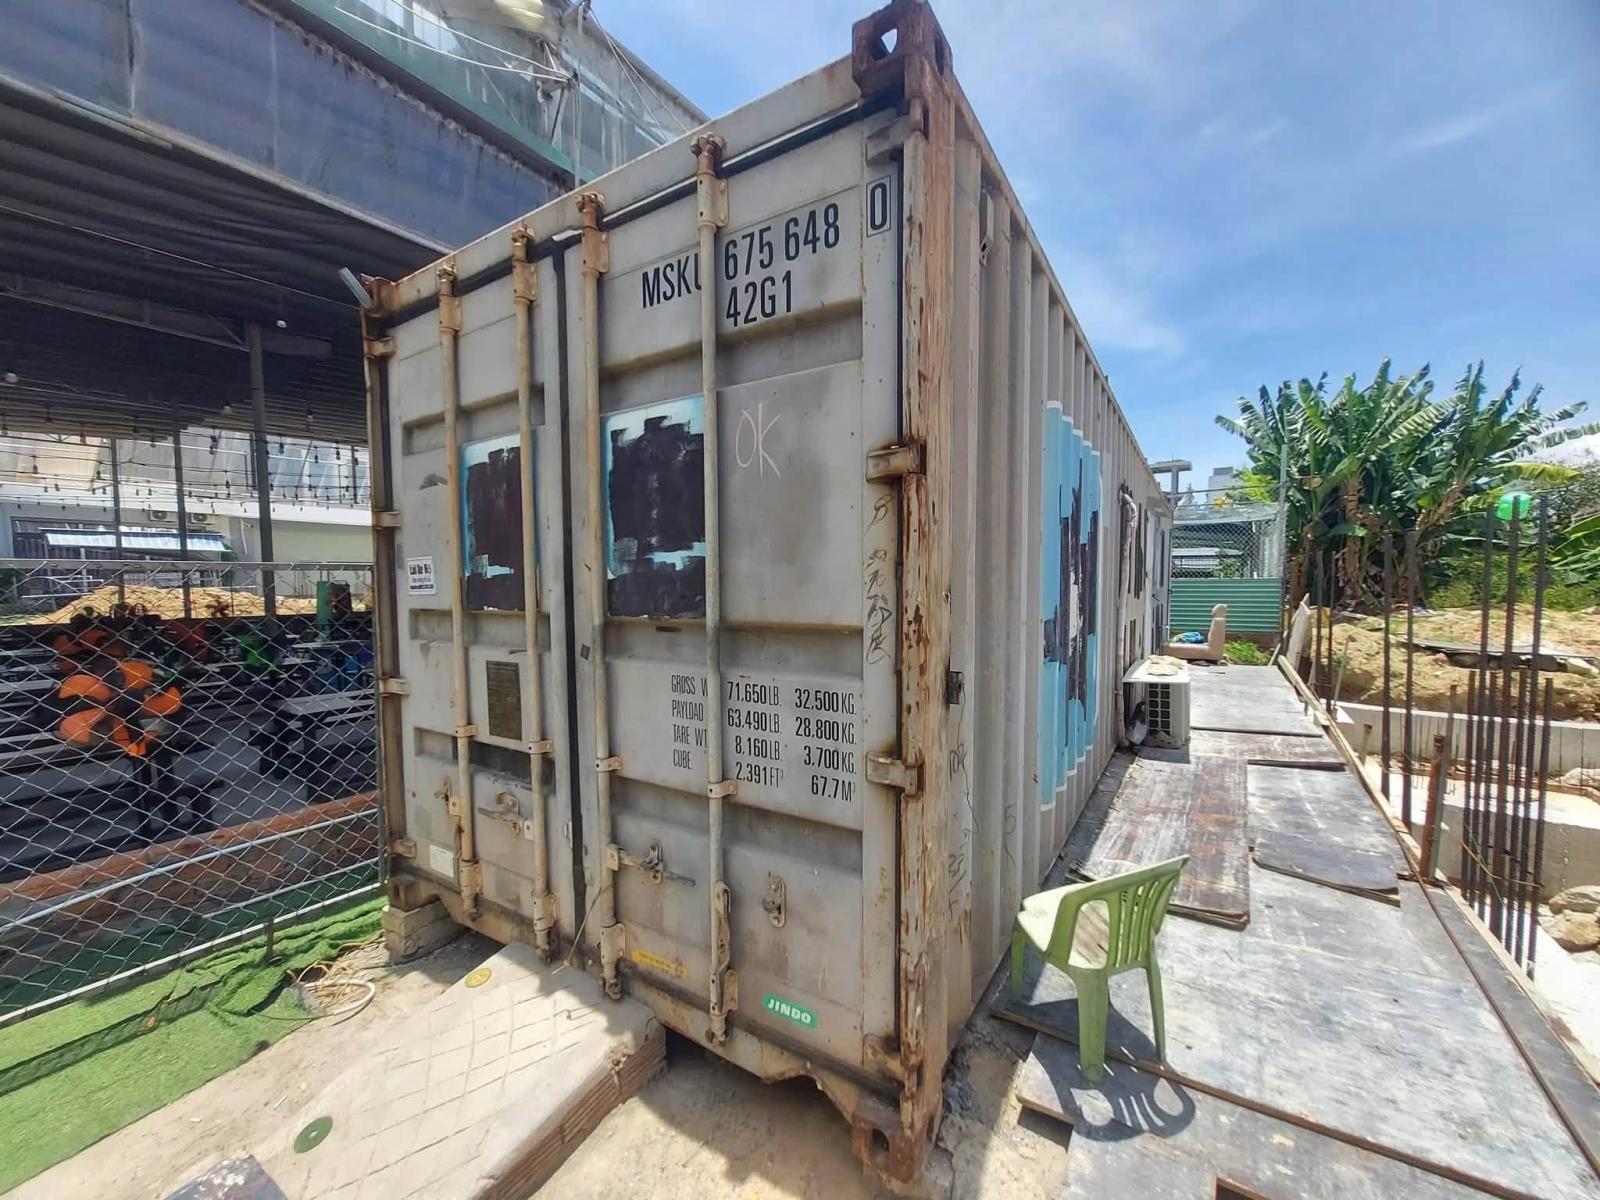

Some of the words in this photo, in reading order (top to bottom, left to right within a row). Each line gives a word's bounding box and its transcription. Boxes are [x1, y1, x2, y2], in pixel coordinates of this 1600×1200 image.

[724, 226, 774, 281] 675
[784, 203, 840, 261] 648
[726, 270, 792, 327] 42G1
[735, 402, 782, 479] OK
[671, 674, 696, 695] GROSS
[672, 699, 704, 722] PAYLOAD
[672, 724, 691, 744] TARE
[672, 748, 692, 770] CUBE
[767, 998, 812, 1024] JINDO
